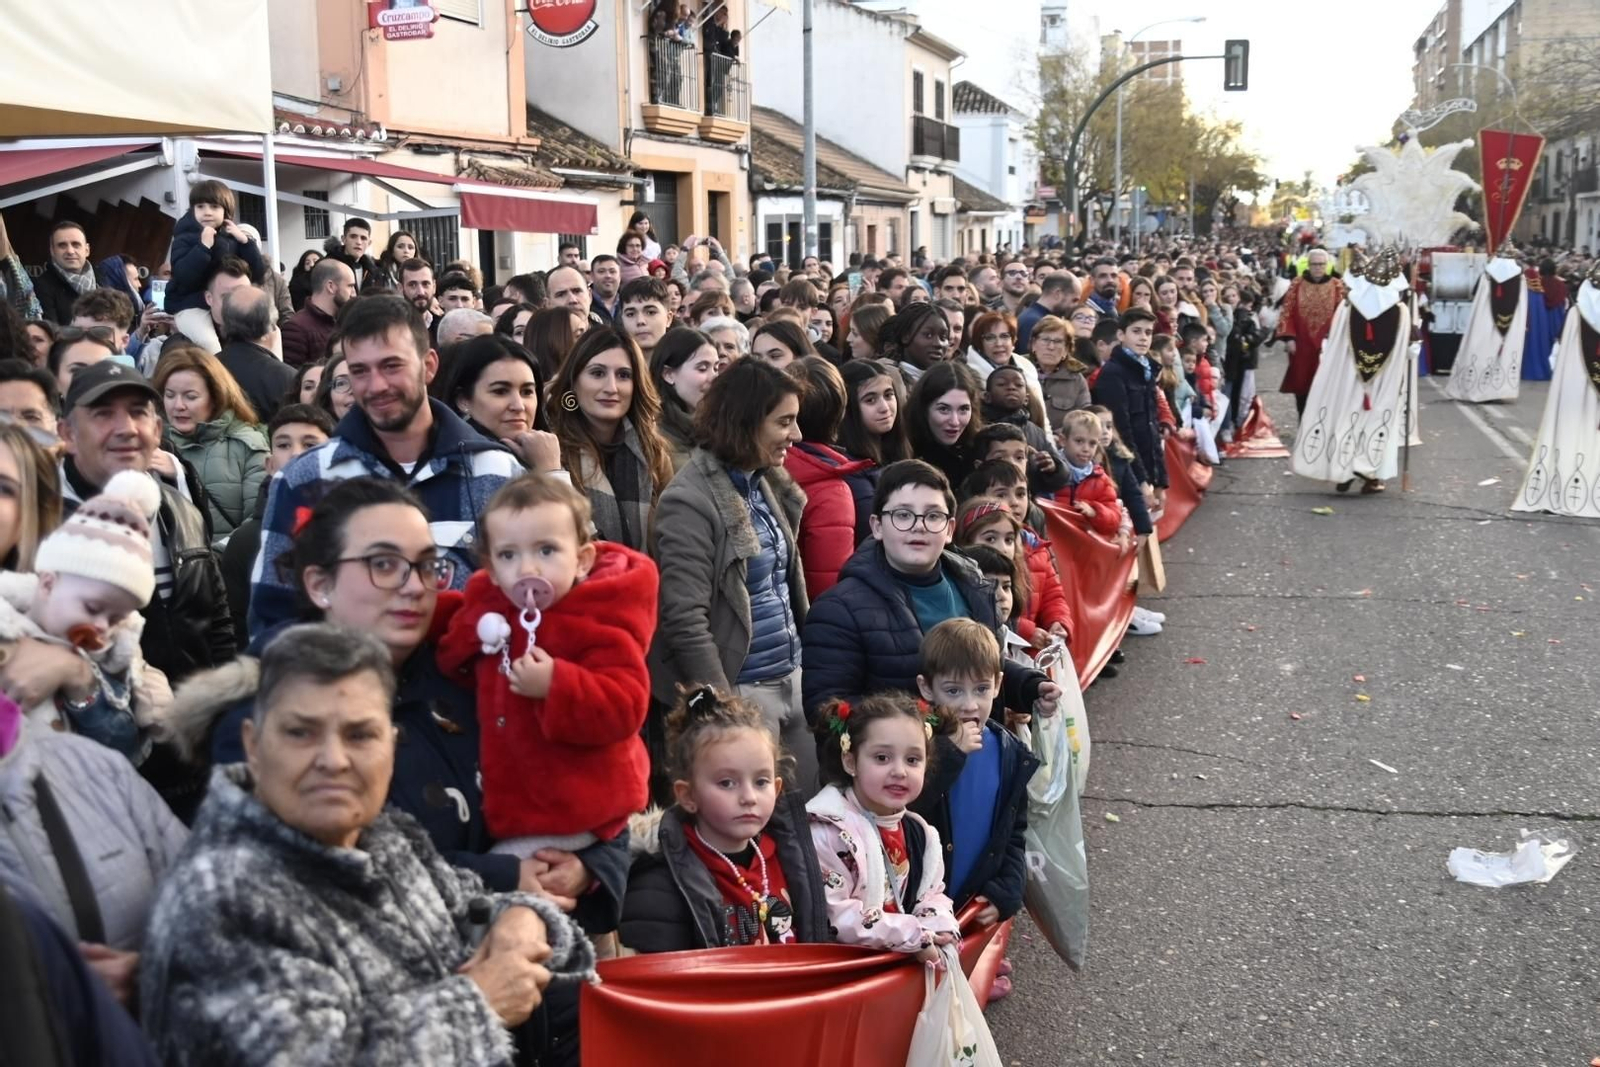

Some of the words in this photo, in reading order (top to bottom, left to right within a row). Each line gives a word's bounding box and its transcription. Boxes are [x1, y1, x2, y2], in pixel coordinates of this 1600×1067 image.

[381, 11, 431, 23] Cruzcampo
[398, 23, 424, 31] DELIRIO
[386, 30, 427, 38] GASTROBAR
[537, 32, 560, 45] DELIRIO
[561, 24, 592, 45] GASTROBAR
